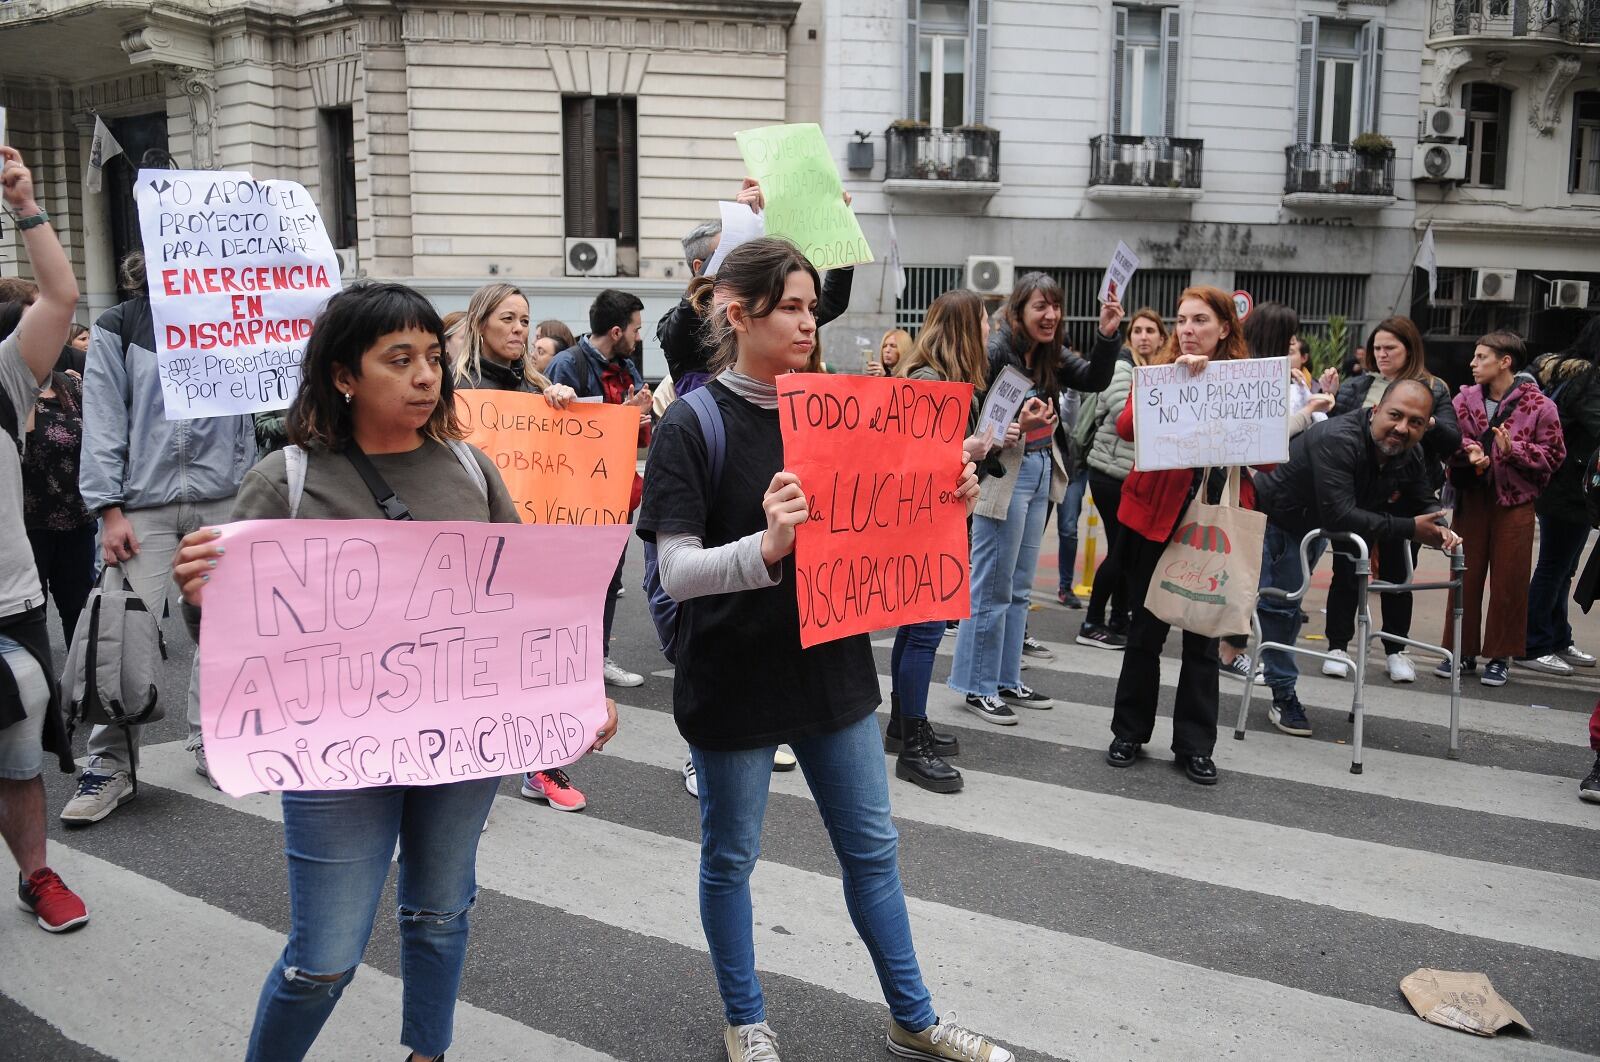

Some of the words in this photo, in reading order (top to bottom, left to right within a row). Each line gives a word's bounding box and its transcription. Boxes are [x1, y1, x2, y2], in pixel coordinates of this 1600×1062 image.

[150, 179, 192, 206] YO
[204, 180, 277, 206] APOYO
[280, 190, 304, 209] EL
[160, 211, 269, 237] PROYECTO
[163, 241, 214, 262] PARA
[222, 236, 317, 259] DECLARAR
[162, 265, 331, 296] EMERGENCIA
[231, 294, 264, 320] EN
[205, 345, 303, 377] Presentado
[185, 380, 219, 408] por
[230, 377, 255, 400] el
[1179, 386, 1199, 405] NO
[1207, 380, 1281, 402] PARAMOS
[480, 401, 604, 439] QUEREMOS
[780, 389, 860, 431] TODO
[869, 406, 883, 433] el
[883, 384, 962, 444] APOYO
[1159, 405, 1179, 424] NO
[481, 445, 575, 477] OBRAR
[590, 457, 608, 480] A
[805, 495, 825, 522] la
[830, 472, 933, 534] LUCHA
[251, 537, 380, 636] NO
[404, 532, 514, 621] AL
[798, 553, 964, 628] DISCAPACIDAD
[215, 626, 499, 739] AJUSTE
[520, 624, 588, 691] EN
